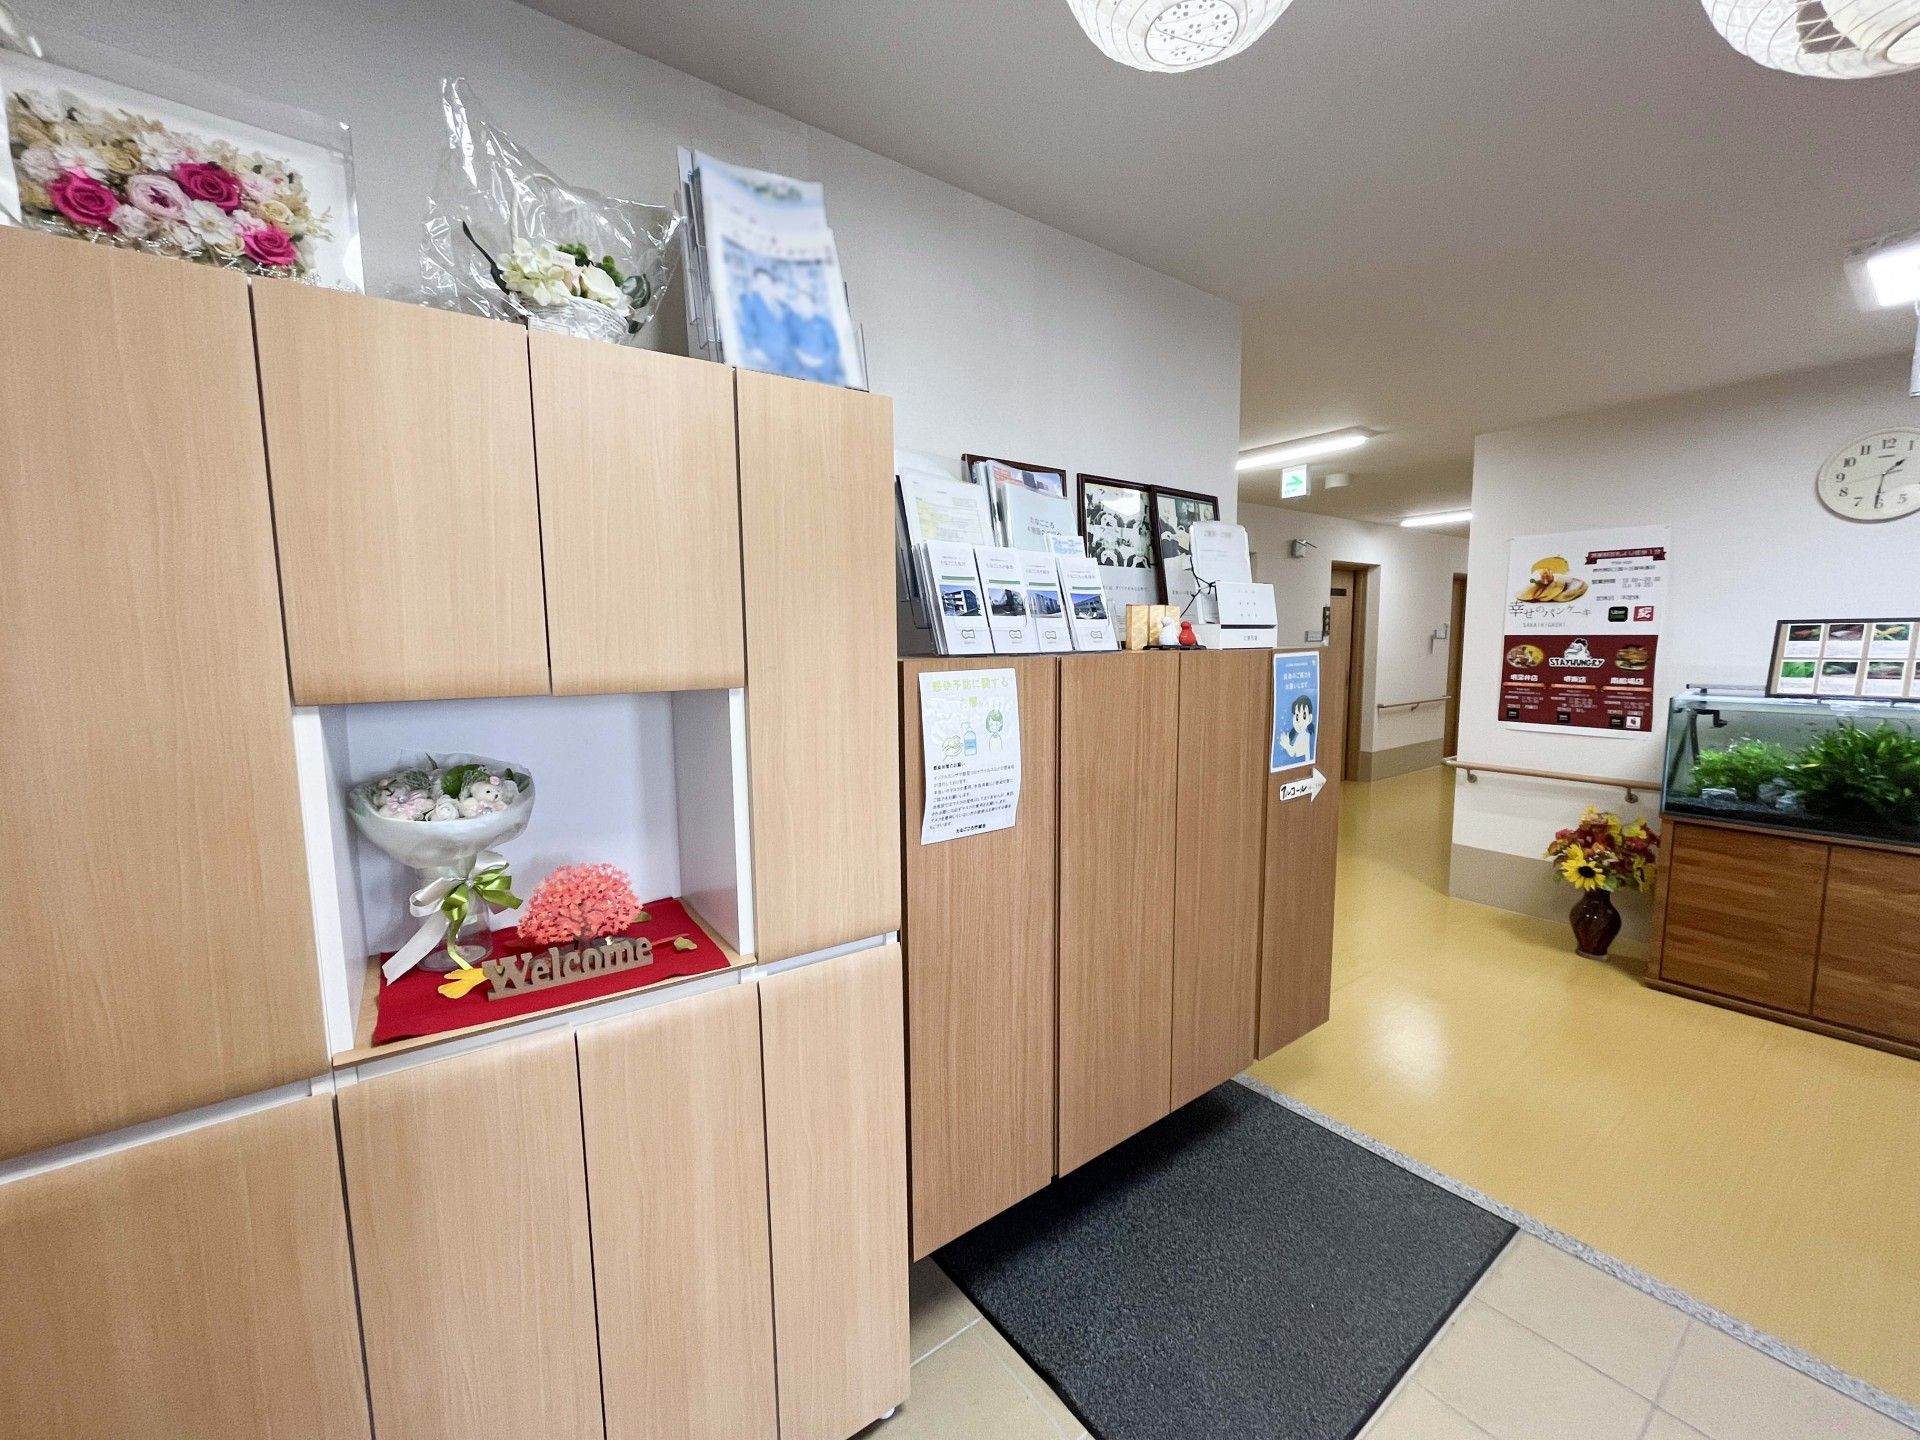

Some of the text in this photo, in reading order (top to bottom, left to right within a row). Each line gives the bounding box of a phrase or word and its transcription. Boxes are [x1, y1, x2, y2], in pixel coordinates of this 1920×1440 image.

[1882, 438, 1897, 449] 12
[1908, 440, 1914, 451] 1
[1860, 445, 1871, 455] 11
[1843, 457, 1856, 467] 10
[1836, 473, 1846, 482] 9
[1839, 487, 1848, 497] 8
[1854, 496, 1863, 506] 7
[1897, 493, 1907, 504] 5
[1508, 601, 1592, 619] 幸せのパンケーキ
[1550, 658, 1604, 667] STAYHUNGRY
[482, 936, 654, 1002] Welcome
